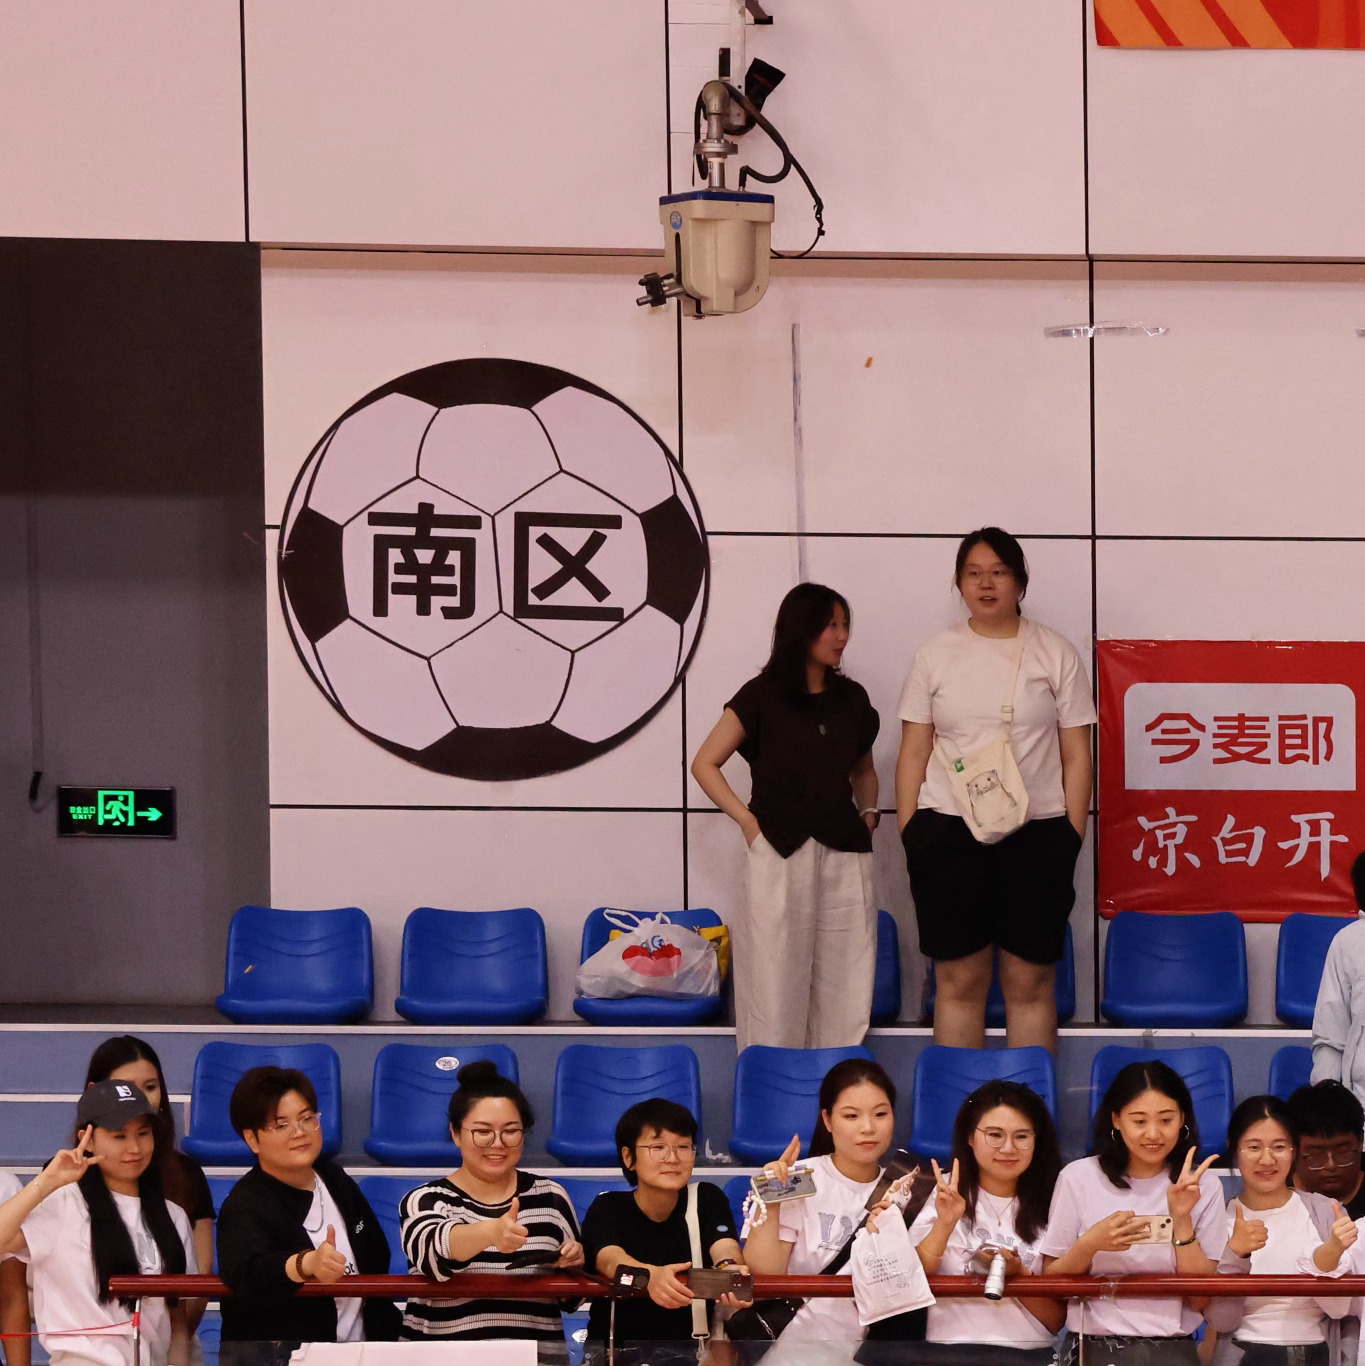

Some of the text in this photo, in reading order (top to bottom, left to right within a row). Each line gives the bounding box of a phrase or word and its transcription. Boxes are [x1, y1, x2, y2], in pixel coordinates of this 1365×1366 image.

[367, 502, 624, 621] 南区
[1145, 712, 1334, 765] 今麦郎
[1132, 807, 1349, 881] 凉白开
